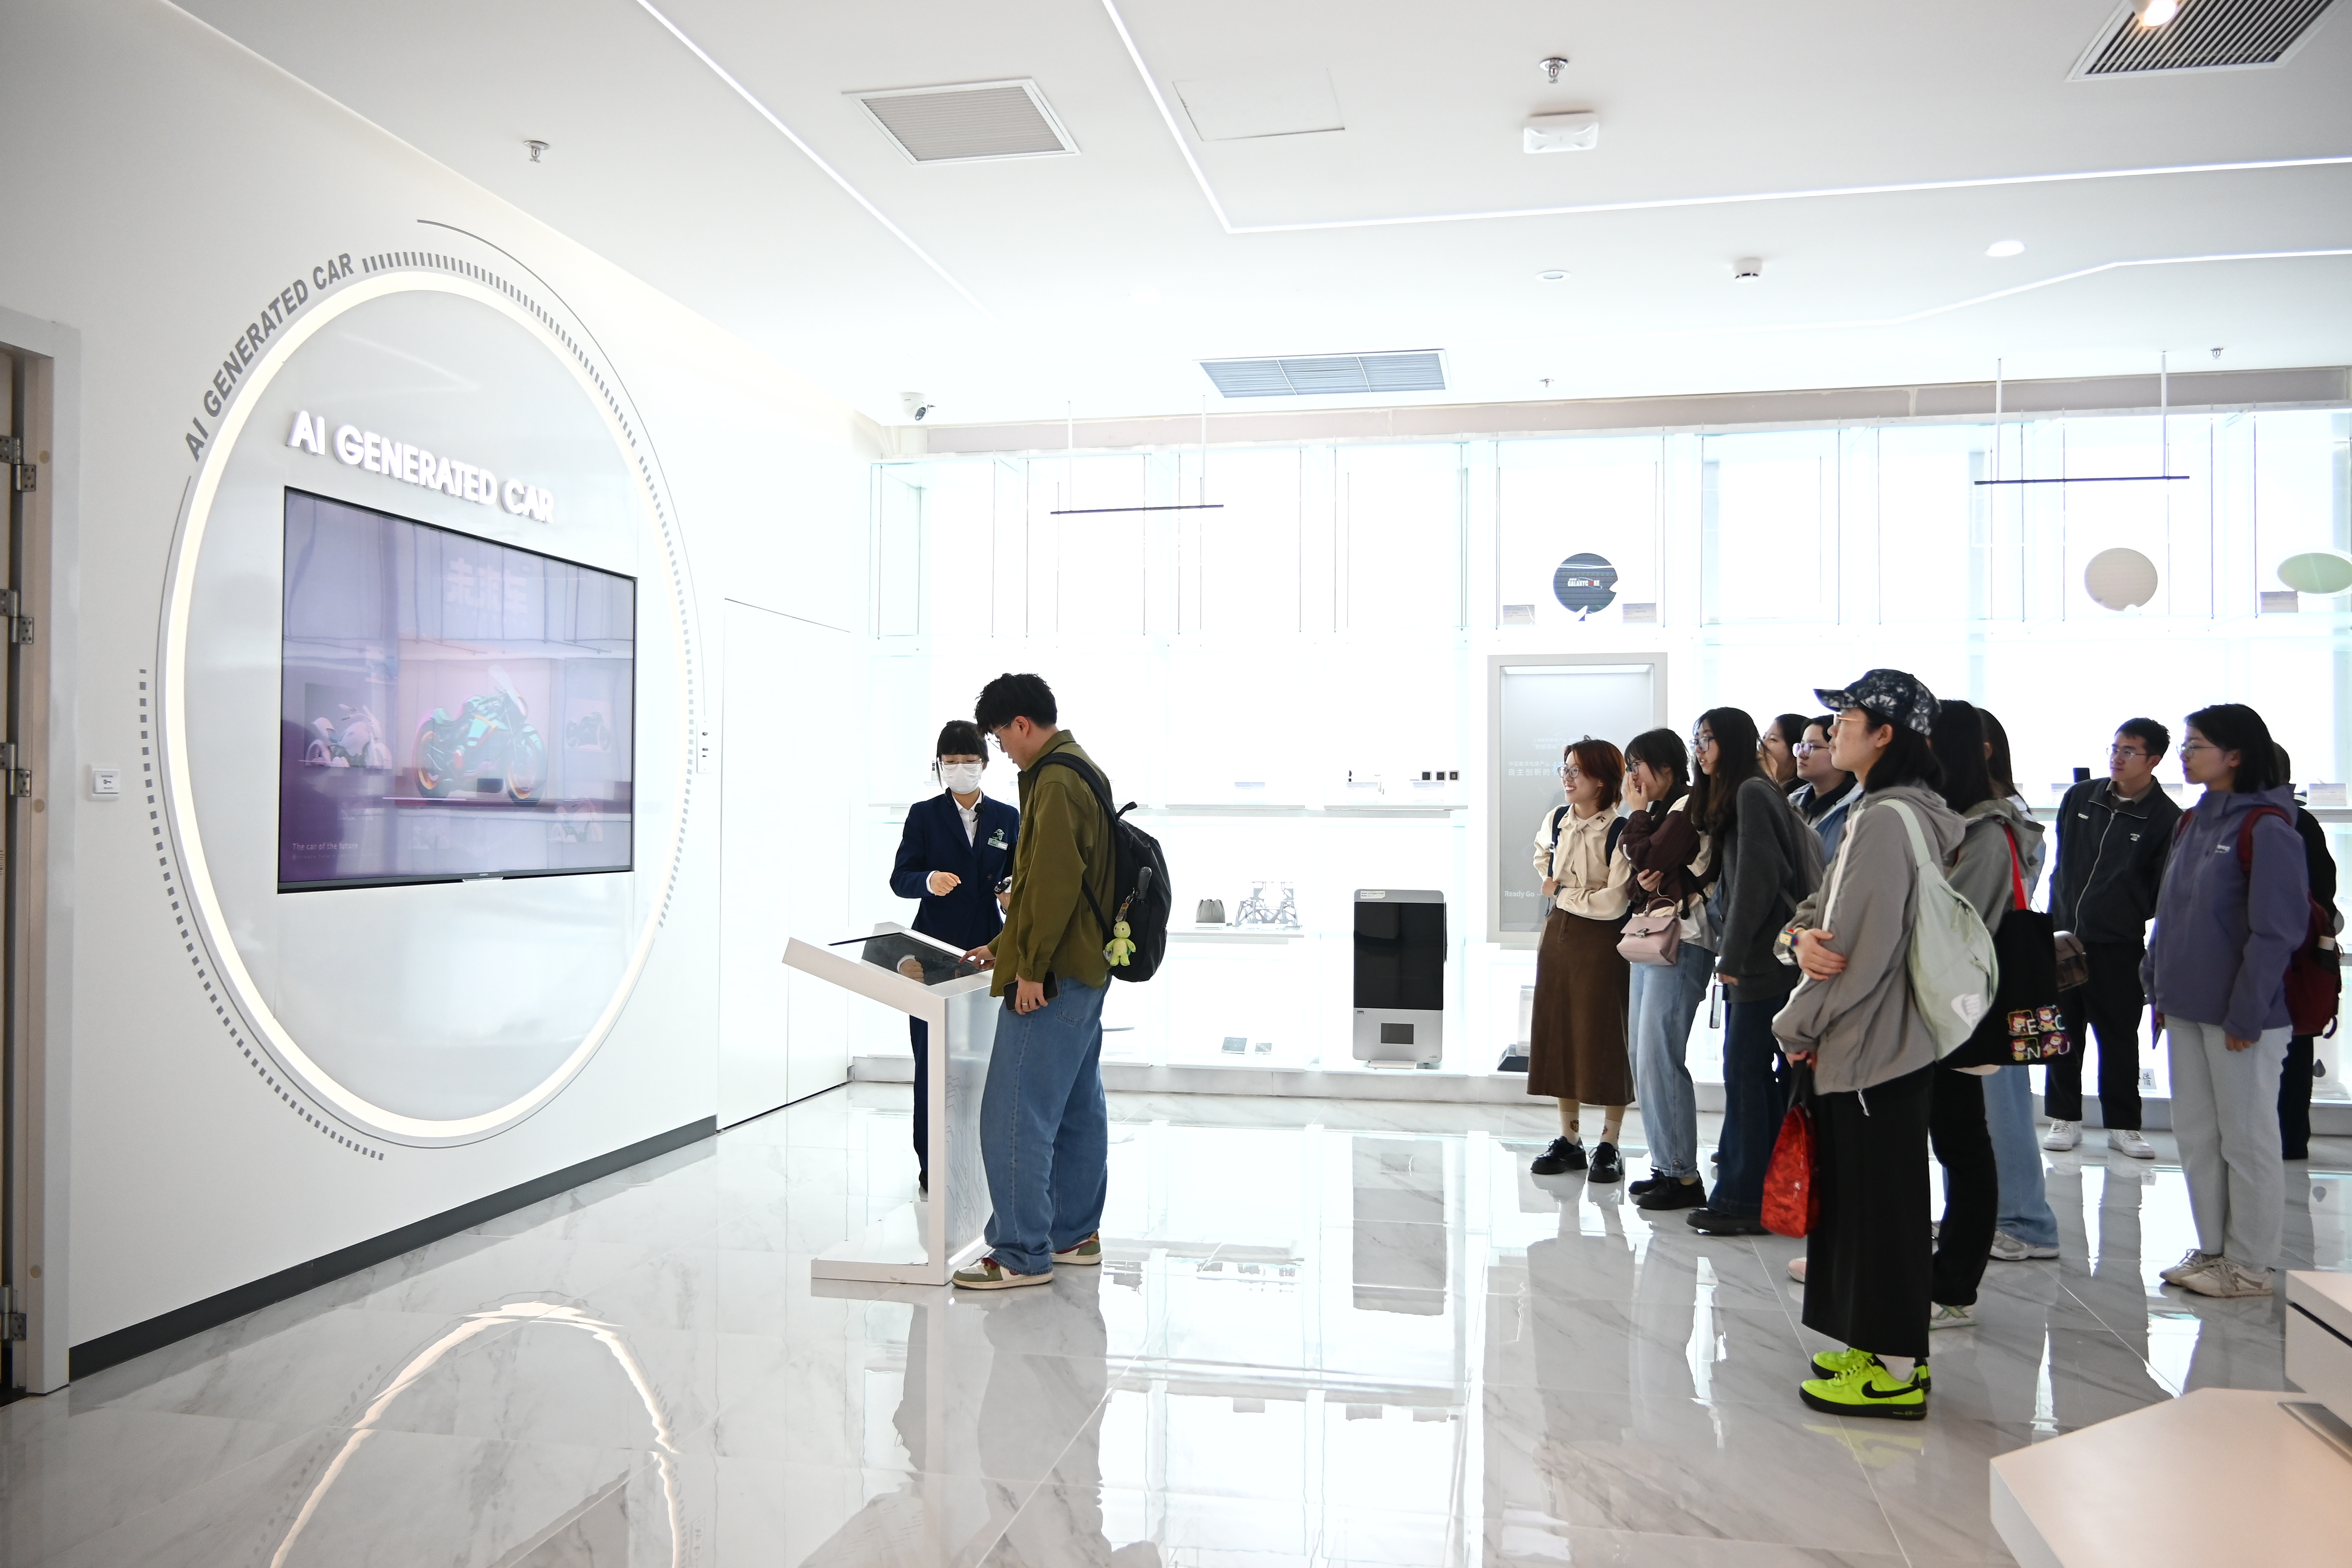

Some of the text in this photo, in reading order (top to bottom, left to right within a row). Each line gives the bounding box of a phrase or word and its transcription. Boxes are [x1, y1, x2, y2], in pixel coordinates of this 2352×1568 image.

[185, 253, 354, 462] AI GENERATED CAR
[286, 411, 554, 523] AI GENERATED CAR
